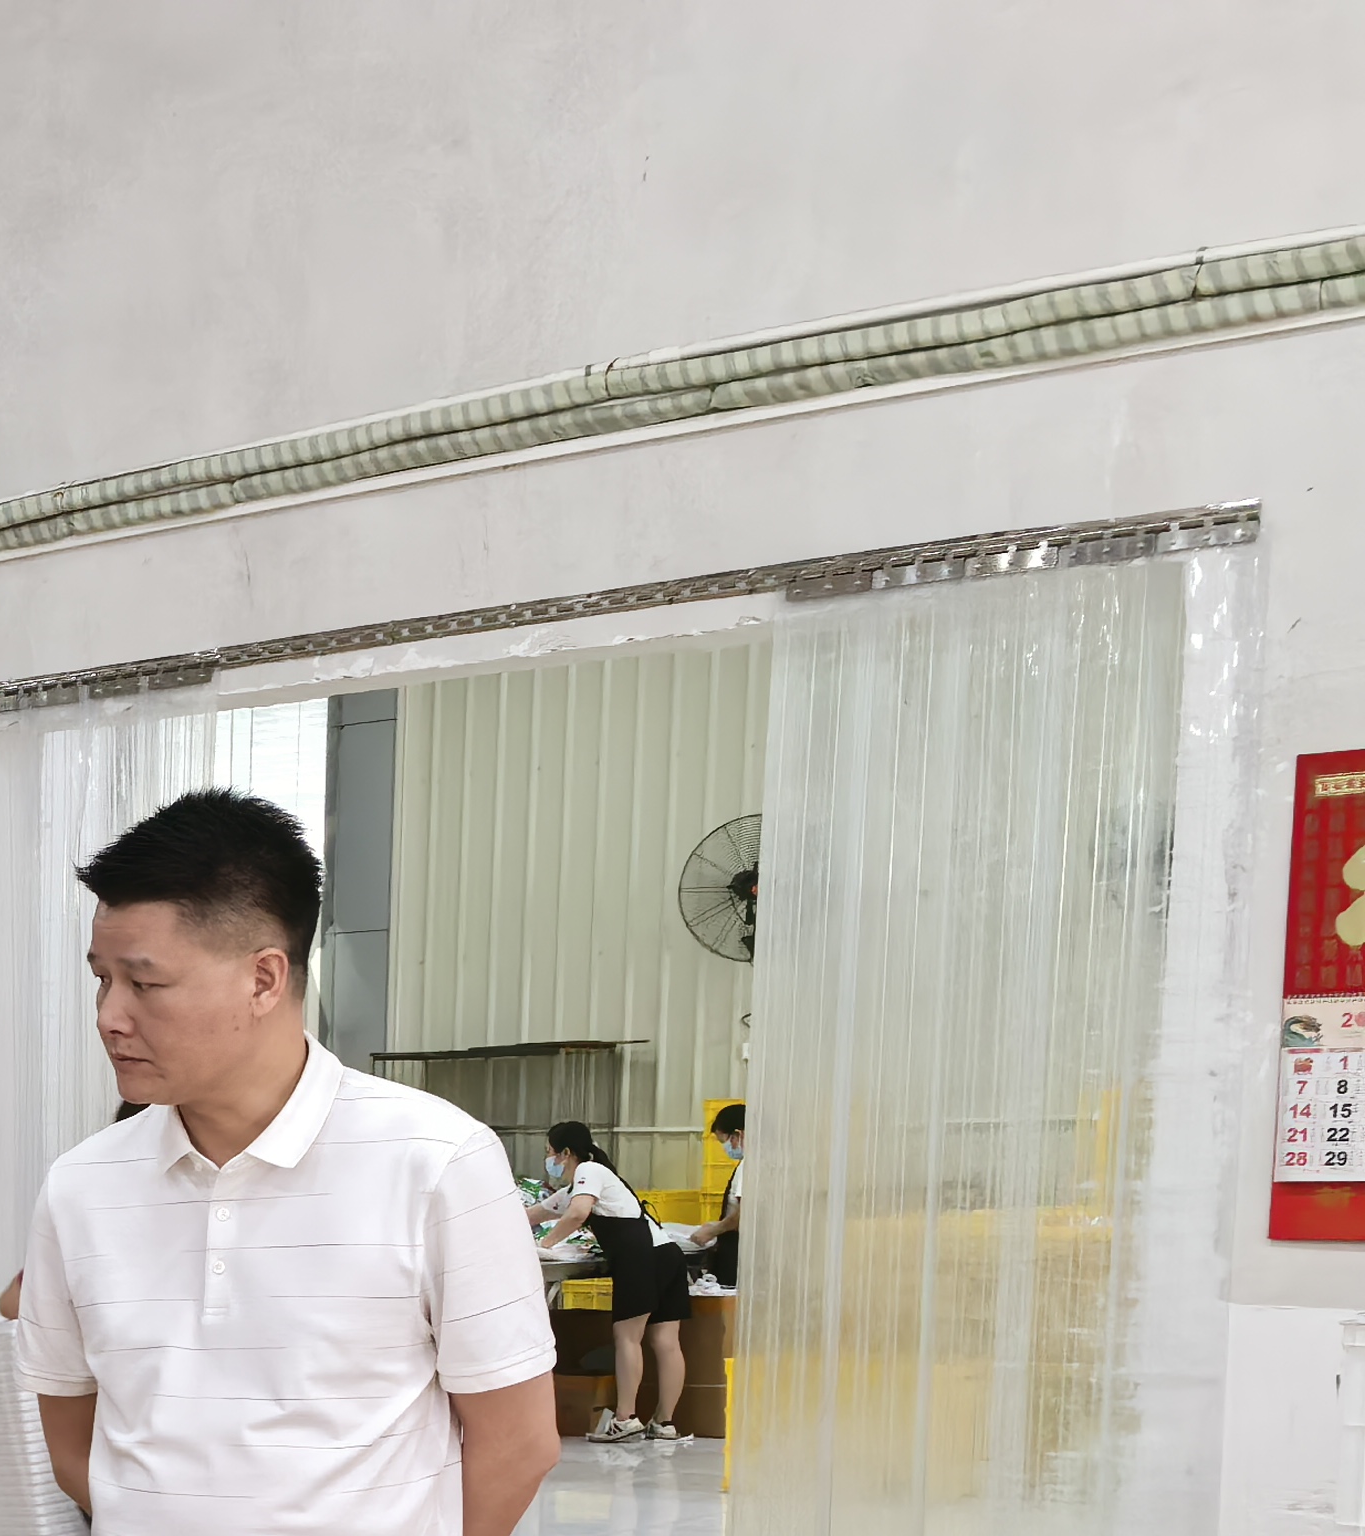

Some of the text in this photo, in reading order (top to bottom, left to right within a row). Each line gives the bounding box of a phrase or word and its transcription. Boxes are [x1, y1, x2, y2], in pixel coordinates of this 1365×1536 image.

[1338, 1055, 1349, 1070] 1
[1296, 1079, 1348, 1094] 7 8
[1288, 1103, 1352, 1118] 14 15
[1286, 1127, 1349, 1142] 21 22
[1284, 1150, 1347, 1166] 28 29
